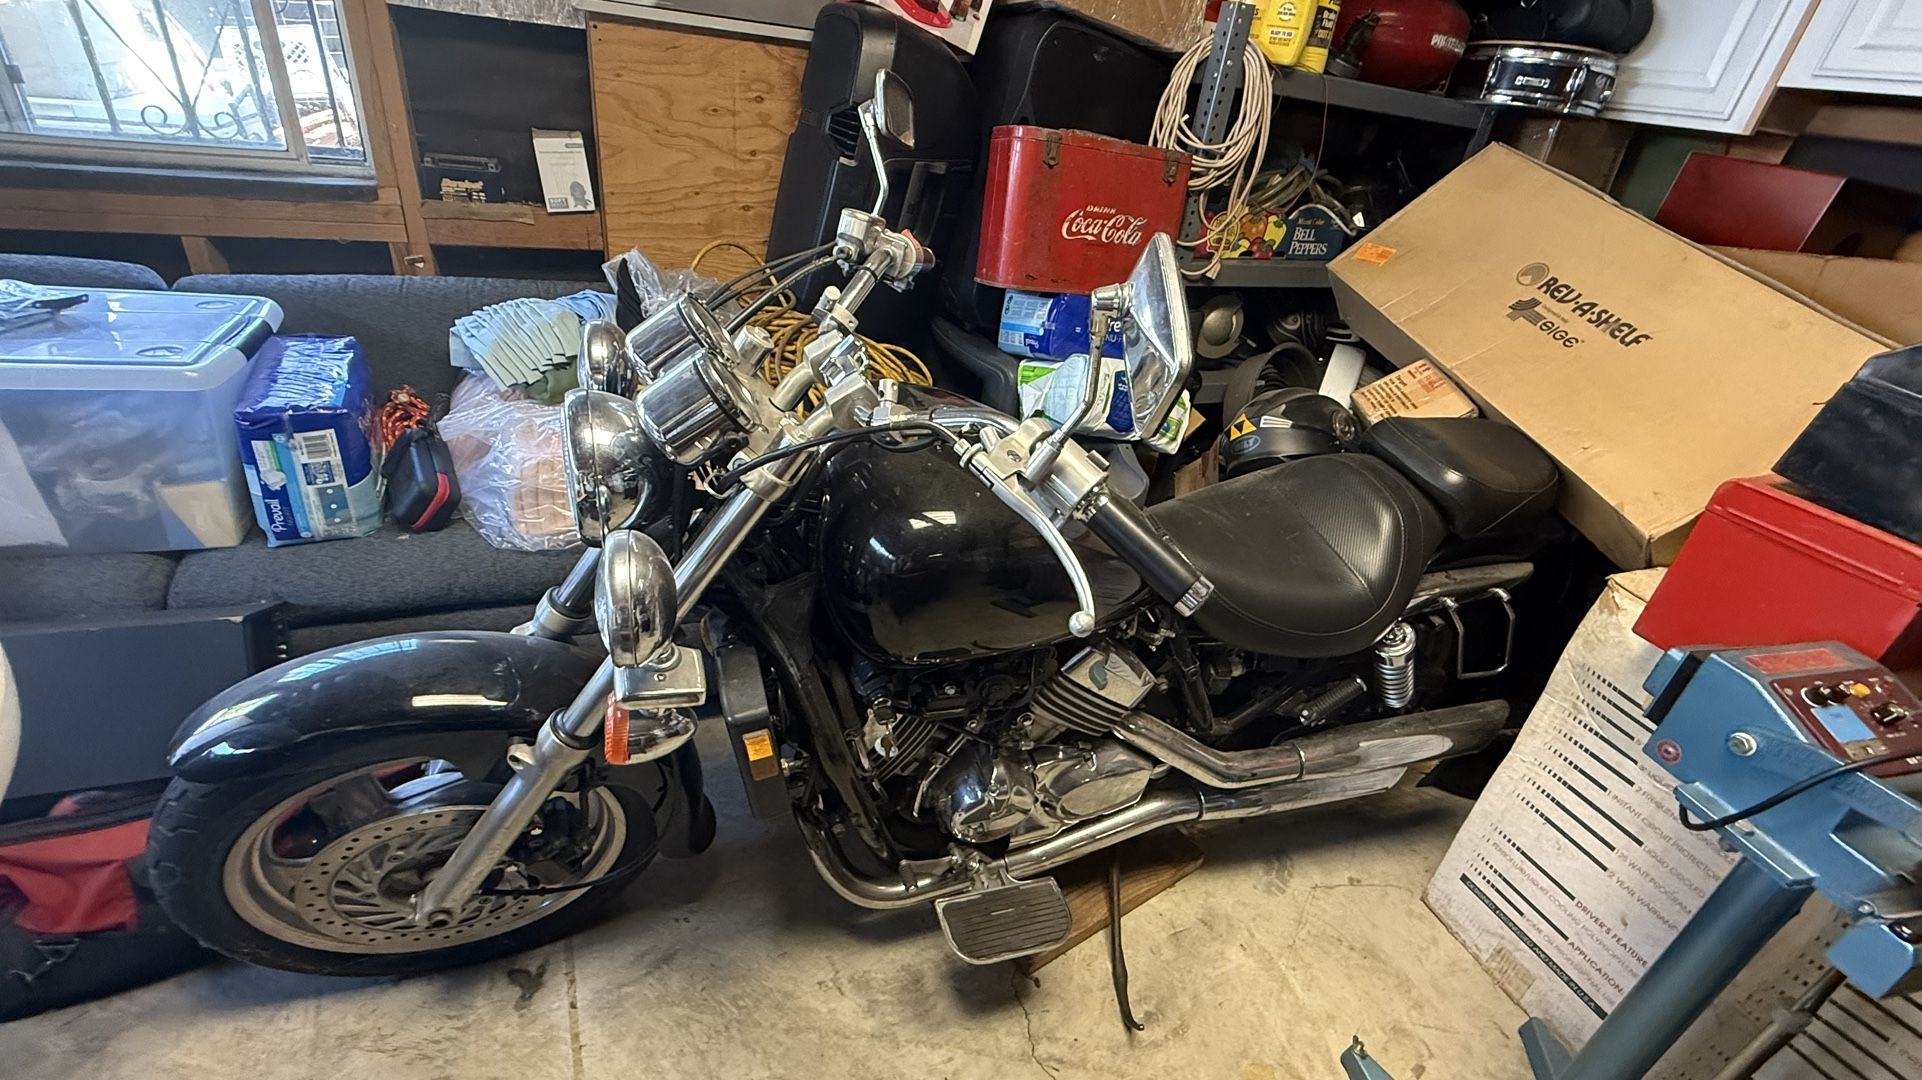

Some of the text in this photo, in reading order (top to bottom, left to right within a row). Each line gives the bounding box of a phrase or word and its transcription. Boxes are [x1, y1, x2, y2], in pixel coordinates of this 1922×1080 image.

[1085, 204, 1117, 215] DRINK
[1060, 208, 1148, 246] Coca-Cola
[1293, 226, 1315, 241] BELL
[1288, 241, 1328, 256] PEPPERS
[264, 498, 287, 534] Prevail
[1574, 899, 1612, 935] DRIVER'S
